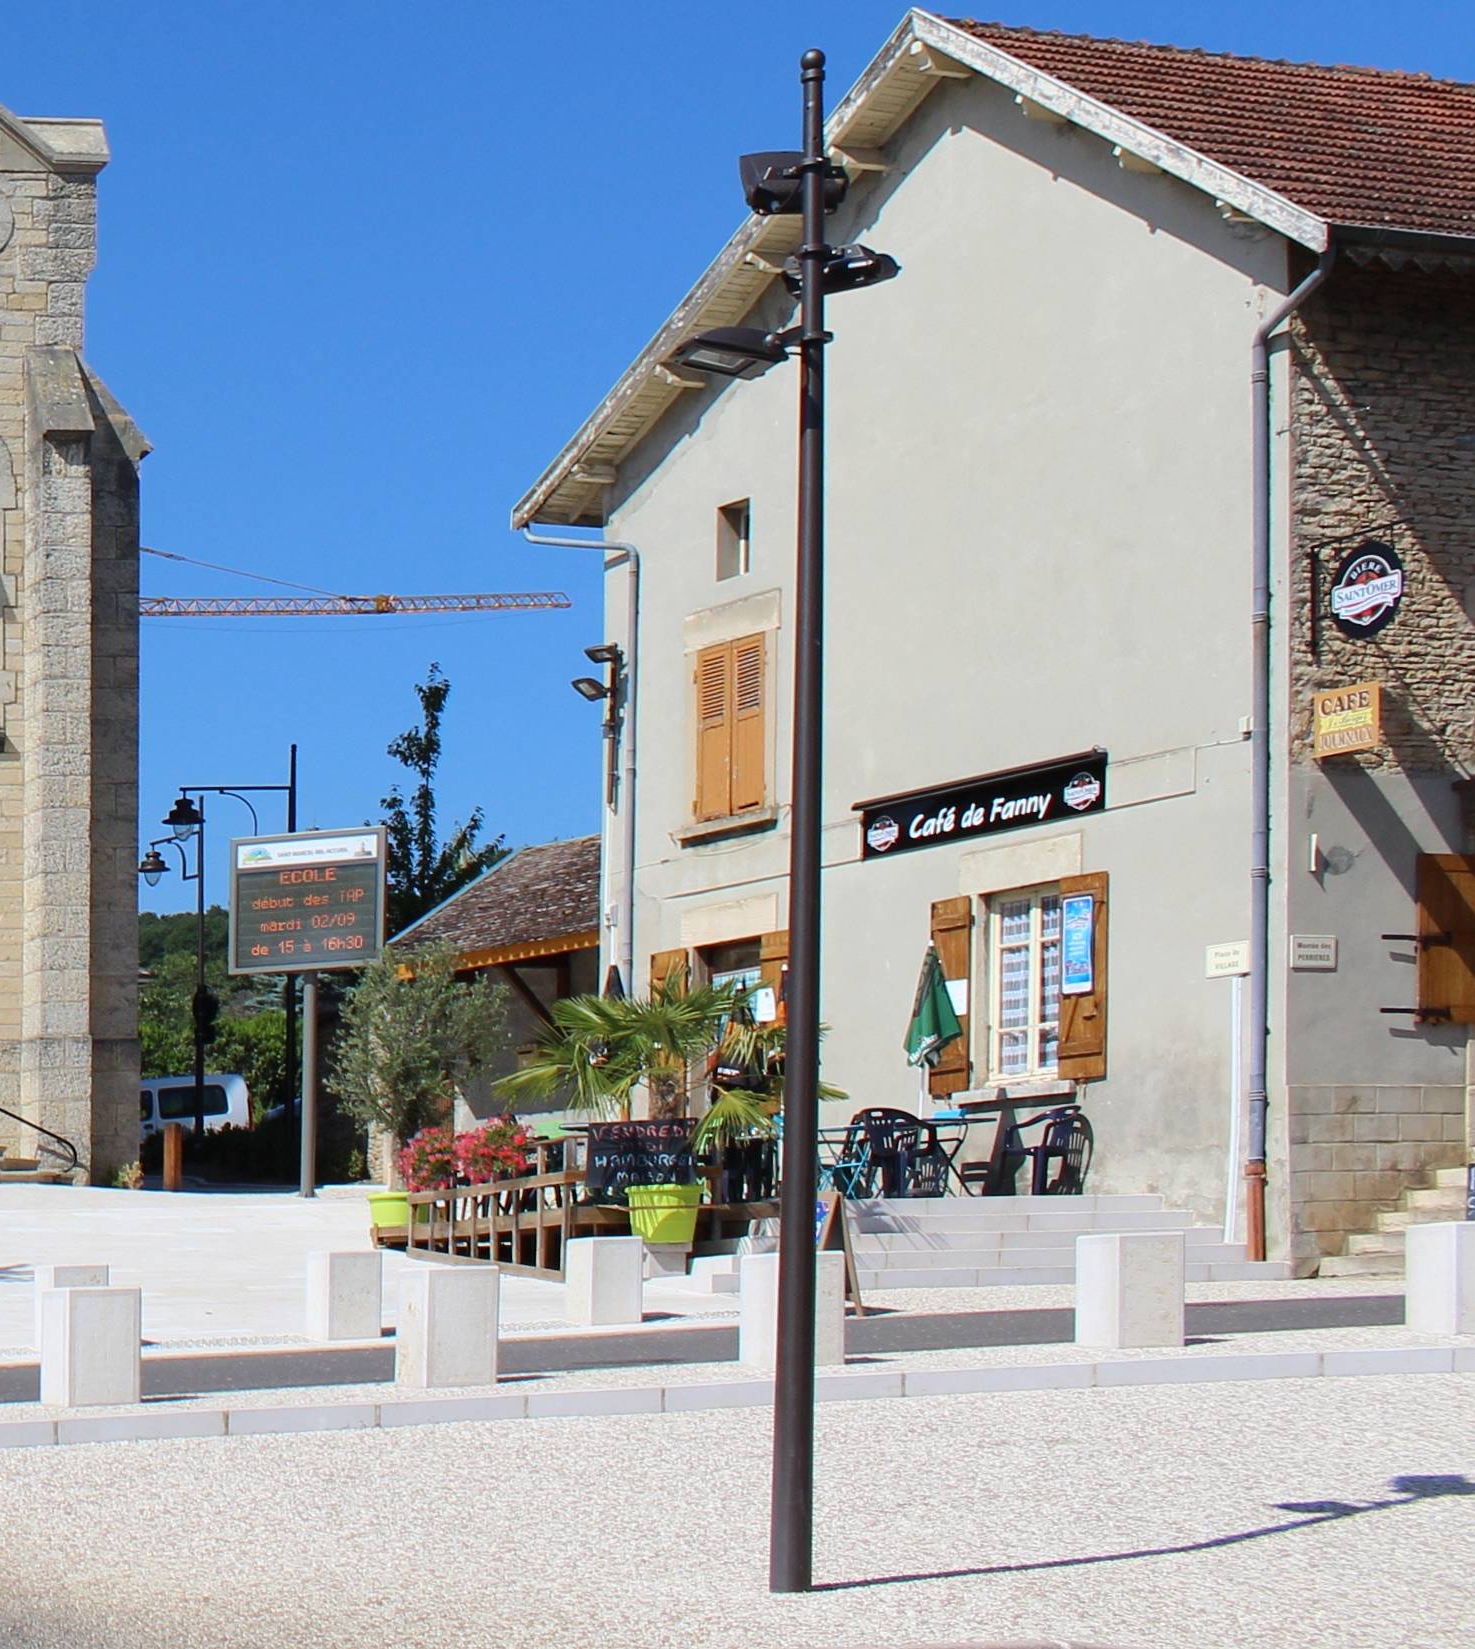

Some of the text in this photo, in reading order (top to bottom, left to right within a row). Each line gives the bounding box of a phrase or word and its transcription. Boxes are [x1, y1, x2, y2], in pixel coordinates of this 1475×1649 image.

[909, 793, 1052, 839] Café de Fanny
[280, 867, 338, 885] ECOLE
[252, 888, 364, 910] début des TAP
[260, 912, 356, 933] mardi 02/09
[251, 935, 363, 956] de 15 à 16h30
